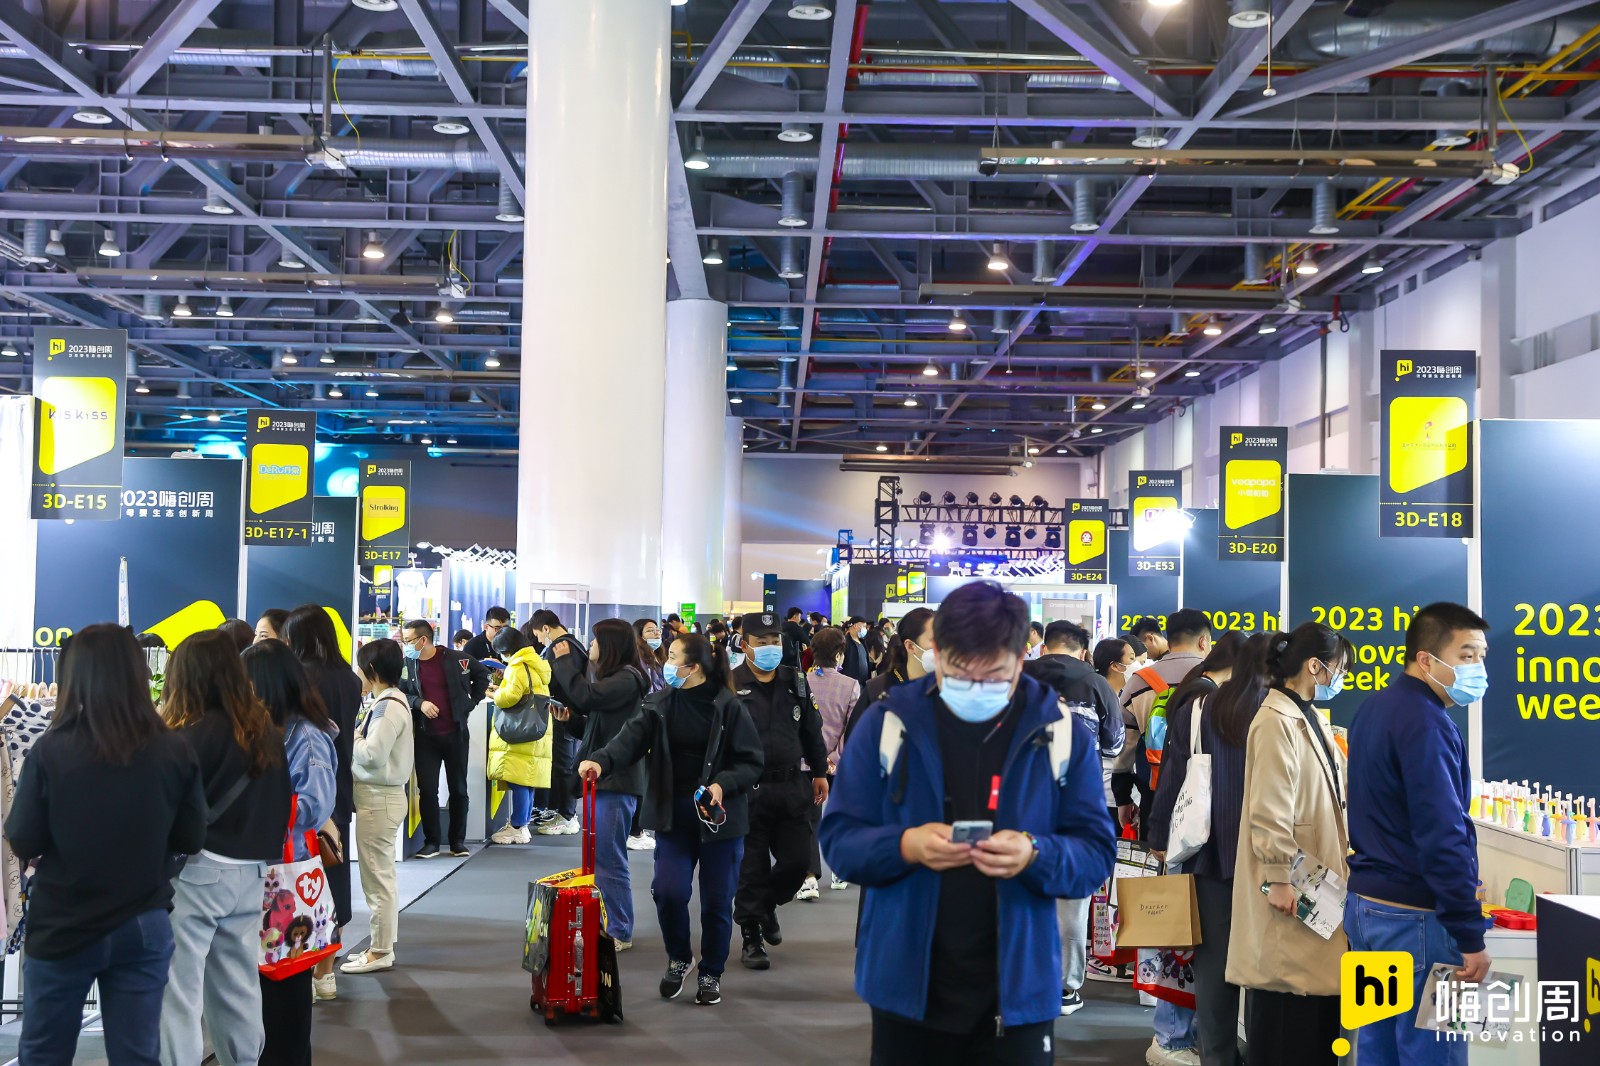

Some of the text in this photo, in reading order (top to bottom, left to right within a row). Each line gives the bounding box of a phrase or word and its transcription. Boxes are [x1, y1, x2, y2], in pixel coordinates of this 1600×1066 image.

[52, 342, 62, 351] hi
[1400, 363, 1410, 372] hi
[42, 493, 107, 510] 3D-E15
[1394, 511, 1463, 527] 3D-E18
[245, 526, 307, 540] 3D-E17-1
[1228, 542, 1277, 554] 3D-E20
[364, 551, 401, 560] 3D-E17
[1136, 561, 1175, 571] 3D-E53
[1071, 573, 1102, 581] 3D-E24
[1516, 646, 1600, 684] inno
[1516, 693, 1600, 721] wee
[299, 874, 321, 899] ty
